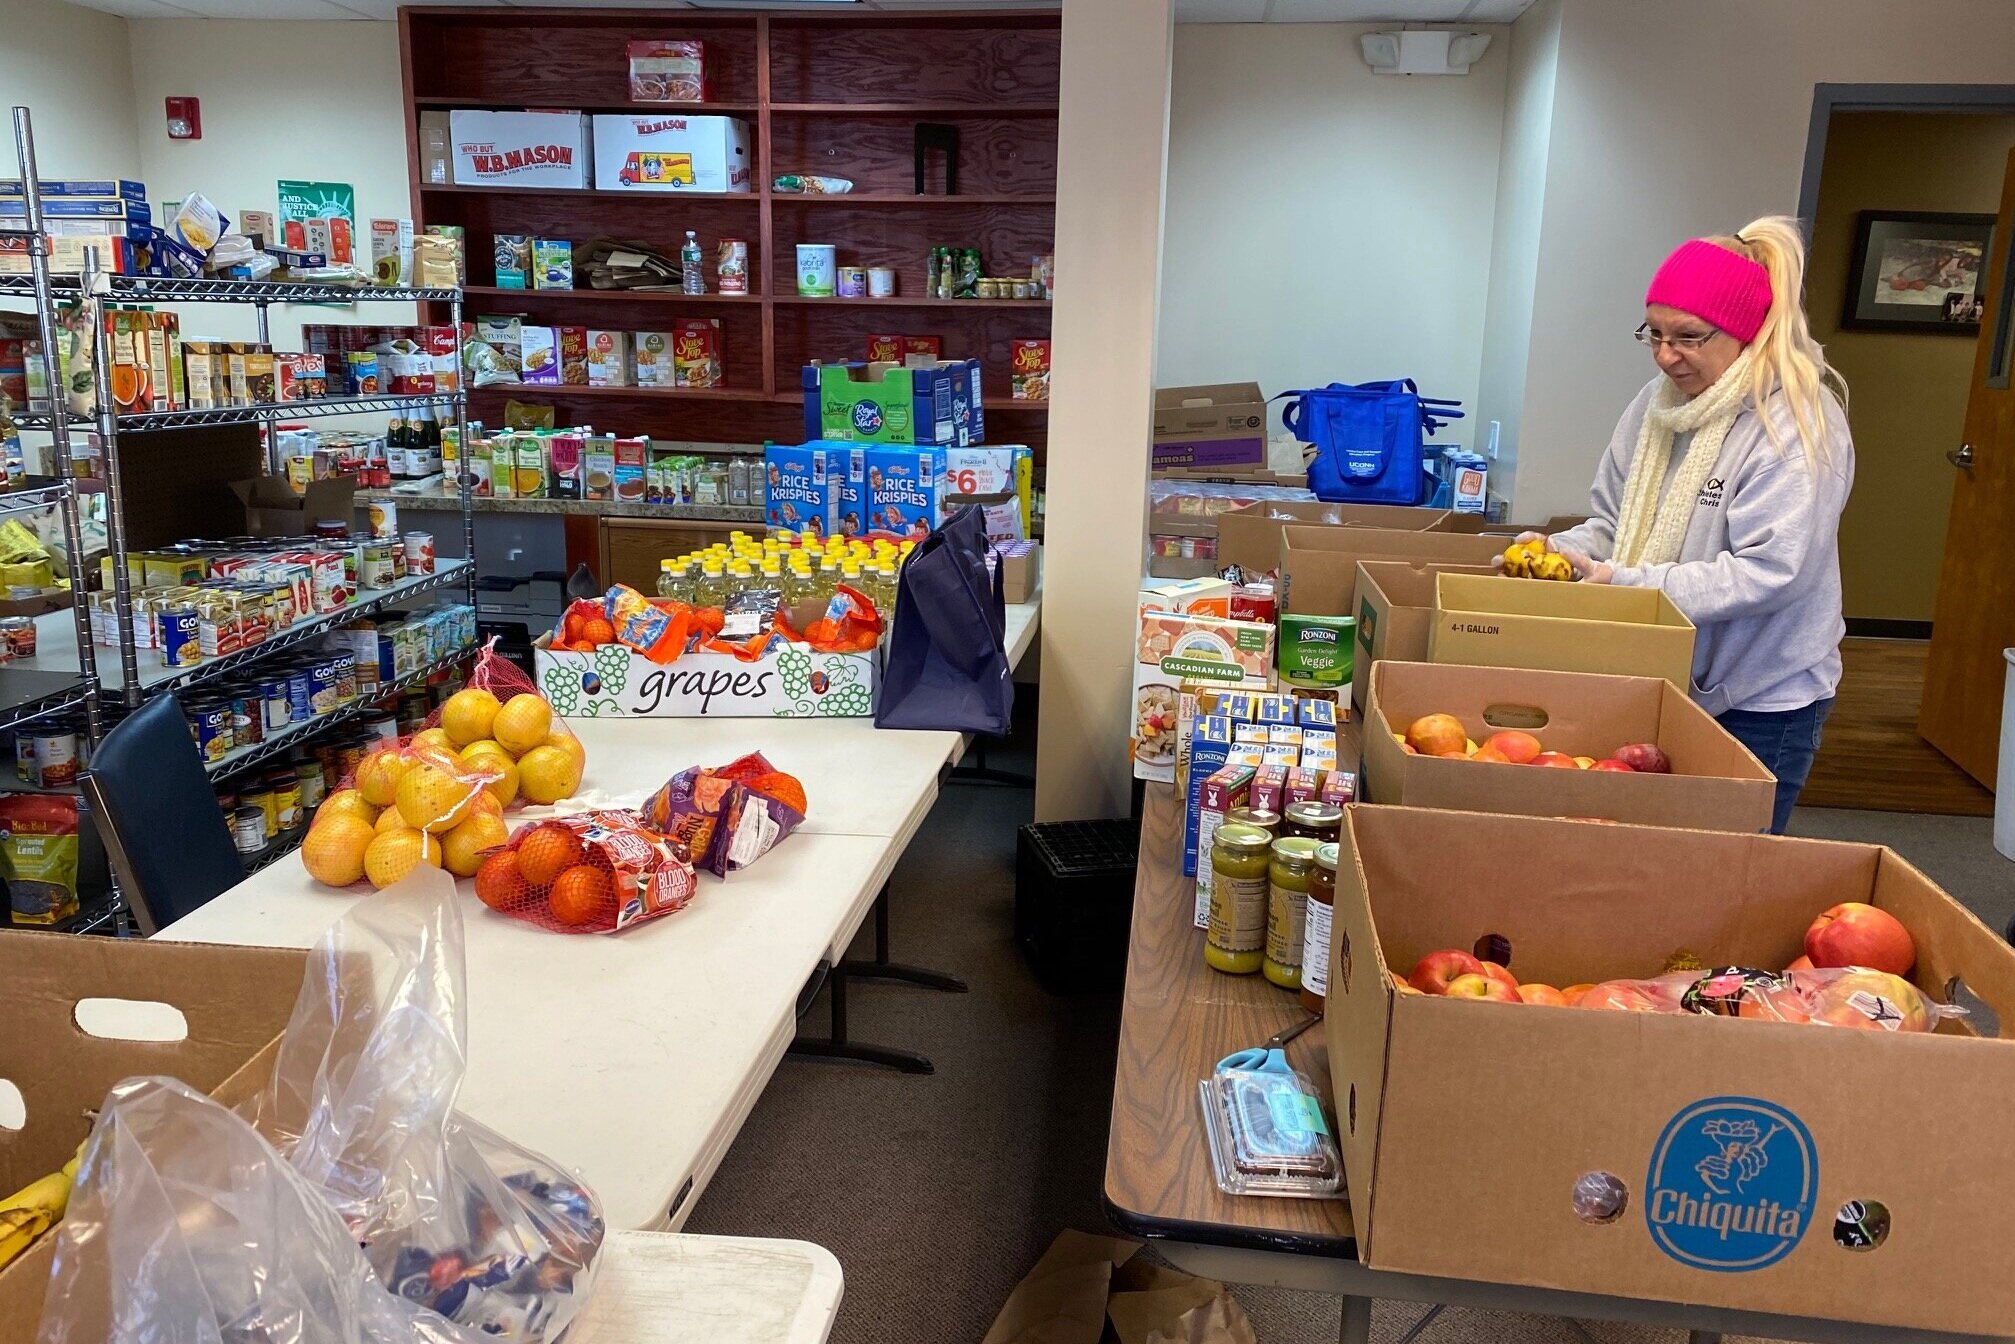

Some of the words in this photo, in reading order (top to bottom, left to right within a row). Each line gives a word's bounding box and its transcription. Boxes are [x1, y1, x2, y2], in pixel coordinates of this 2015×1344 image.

[461, 145, 477, 153] WHO
[472, 144, 572, 172] W.B.MASON
[282, 195, 300, 203] AND
[292, 210, 308, 218] ALL
[434, 334, 455, 346] Camp
[562, 334, 580, 346] tove
[676, 336, 704, 355] Stove
[564, 344, 578, 355] Top
[686, 348, 700, 360] Top
[870, 341, 898, 358] Stove
[1014, 347, 1044, 366] Stove
[1026, 358, 1040, 370] Top
[823, 401, 851, 416] Sweet
[855, 404, 878, 418] Royal
[854, 416, 873, 428] Star
[1152, 454, 1194, 465] amoas
[782, 474, 810, 490] RICE
[886, 478, 915, 492] RICE
[947, 469, 977, 496] $6
[771, 487, 820, 504] KRISPIES
[874, 490, 928, 507] KRISPIES
[1230, 609, 1254, 618] mpbell's
[180, 618, 198, 628] GO
[1301, 630, 1336, 640] RONZONI
[1451, 624, 1464, 632] 4-1
[1466, 624, 1499, 635] GALLON
[334, 656, 354, 668] GOY
[1300, 656, 1334, 669] Veggie
[315, 666, 334, 678] GOY
[1164, 662, 1214, 674] CASCADIAN
[1216, 668, 1240, 677] FARM
[632, 667, 774, 715] grapes
[209, 713, 223, 724] GO
[1180, 732, 1192, 766] Whole
[1195, 752, 1225, 762] RONZONI
[611, 834, 644, 850] BLOOD
[17, 846, 44, 855] Lentils
[658, 868, 686, 889] BLOOD
[659, 885, 688, 902] ORANGES
[1652, 1188, 1802, 1240] Chiquita
